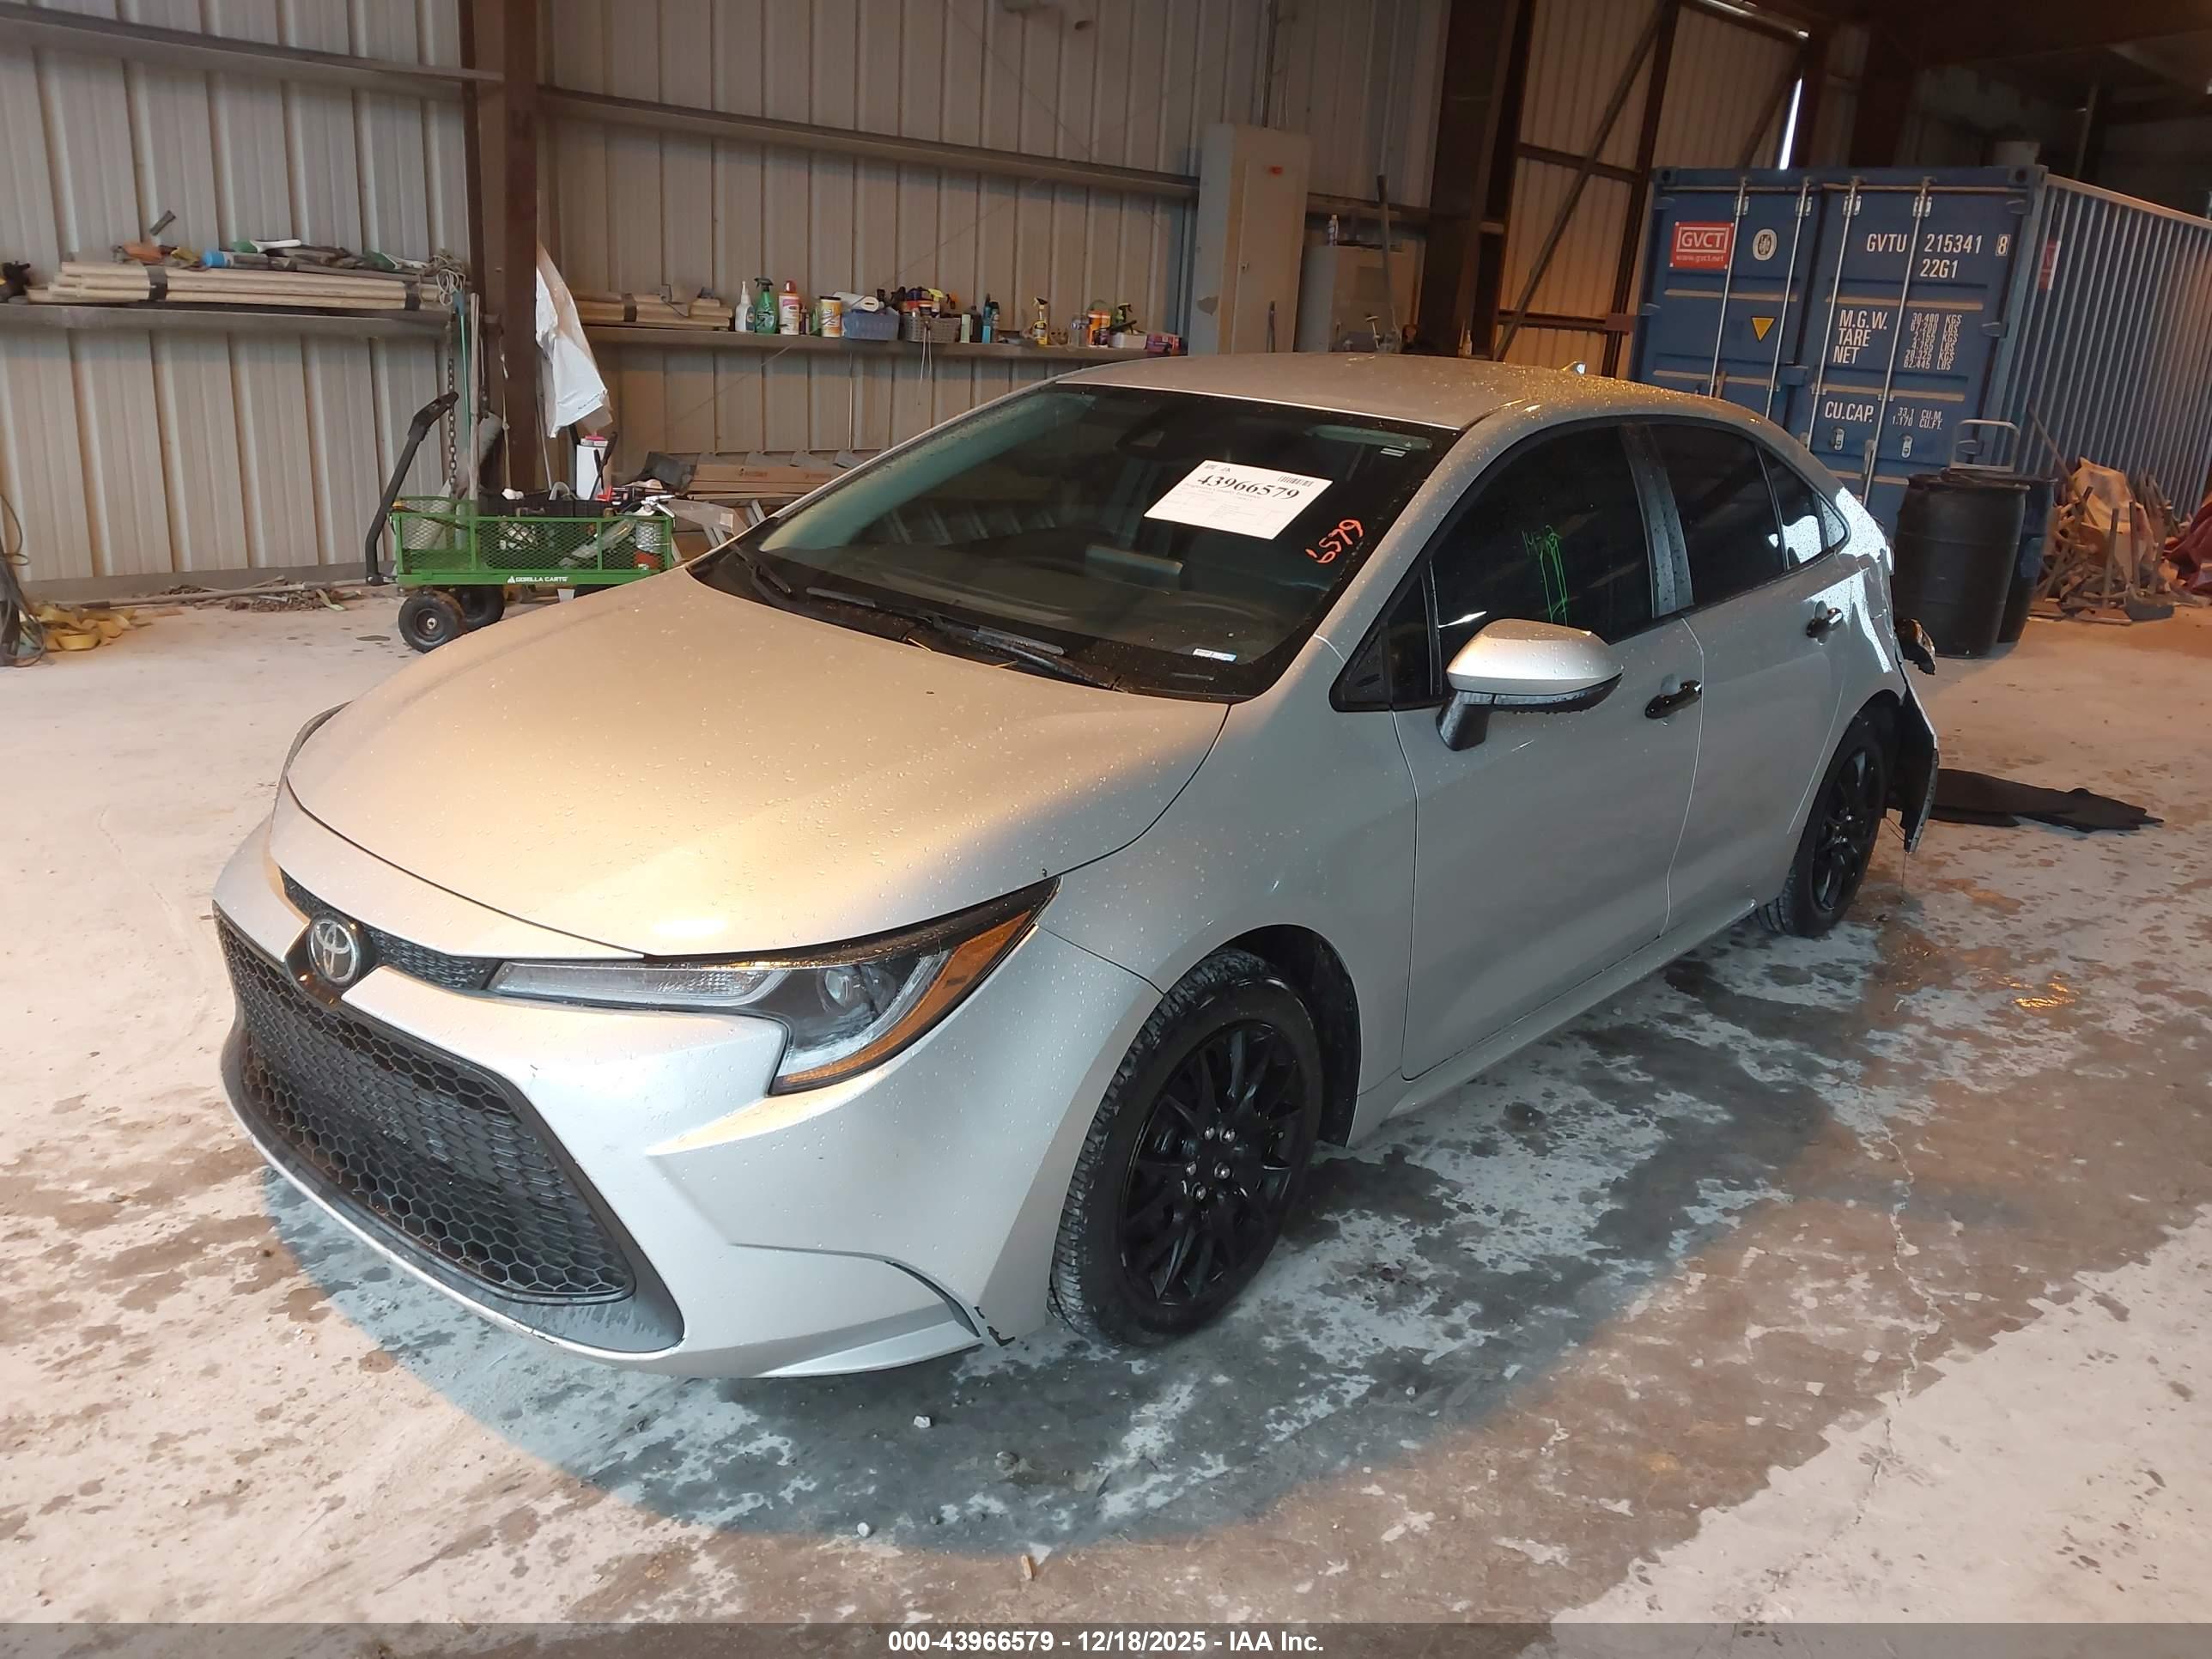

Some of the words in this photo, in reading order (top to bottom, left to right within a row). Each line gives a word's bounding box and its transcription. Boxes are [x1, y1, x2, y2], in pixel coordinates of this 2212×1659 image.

[1681, 231, 1725, 248] GVCT
[1866, 233, 1908, 252] GVTU
[1923, 233, 1983, 254] 215341
[1997, 235, 2008, 255] 8
[1919, 258, 1959, 279] 22G1
[1838, 309, 1888, 331] M.G.W.
[1943, 323, 1960, 334] LBS
[1945, 314, 1963, 325] KGS
[1838, 327, 1872, 347] TARE
[1942, 332, 1959, 343] KGS
[1832, 345, 1861, 365] NET
[1938, 350, 1955, 362] KGS
[1940, 342, 1955, 353] LBS
[1936, 361, 1952, 371] LBS
[1824, 401, 1874, 422] CU.CAP.
[1197, 474, 1300, 500] 43966579
[1305, 519, 1364, 563] 6579
